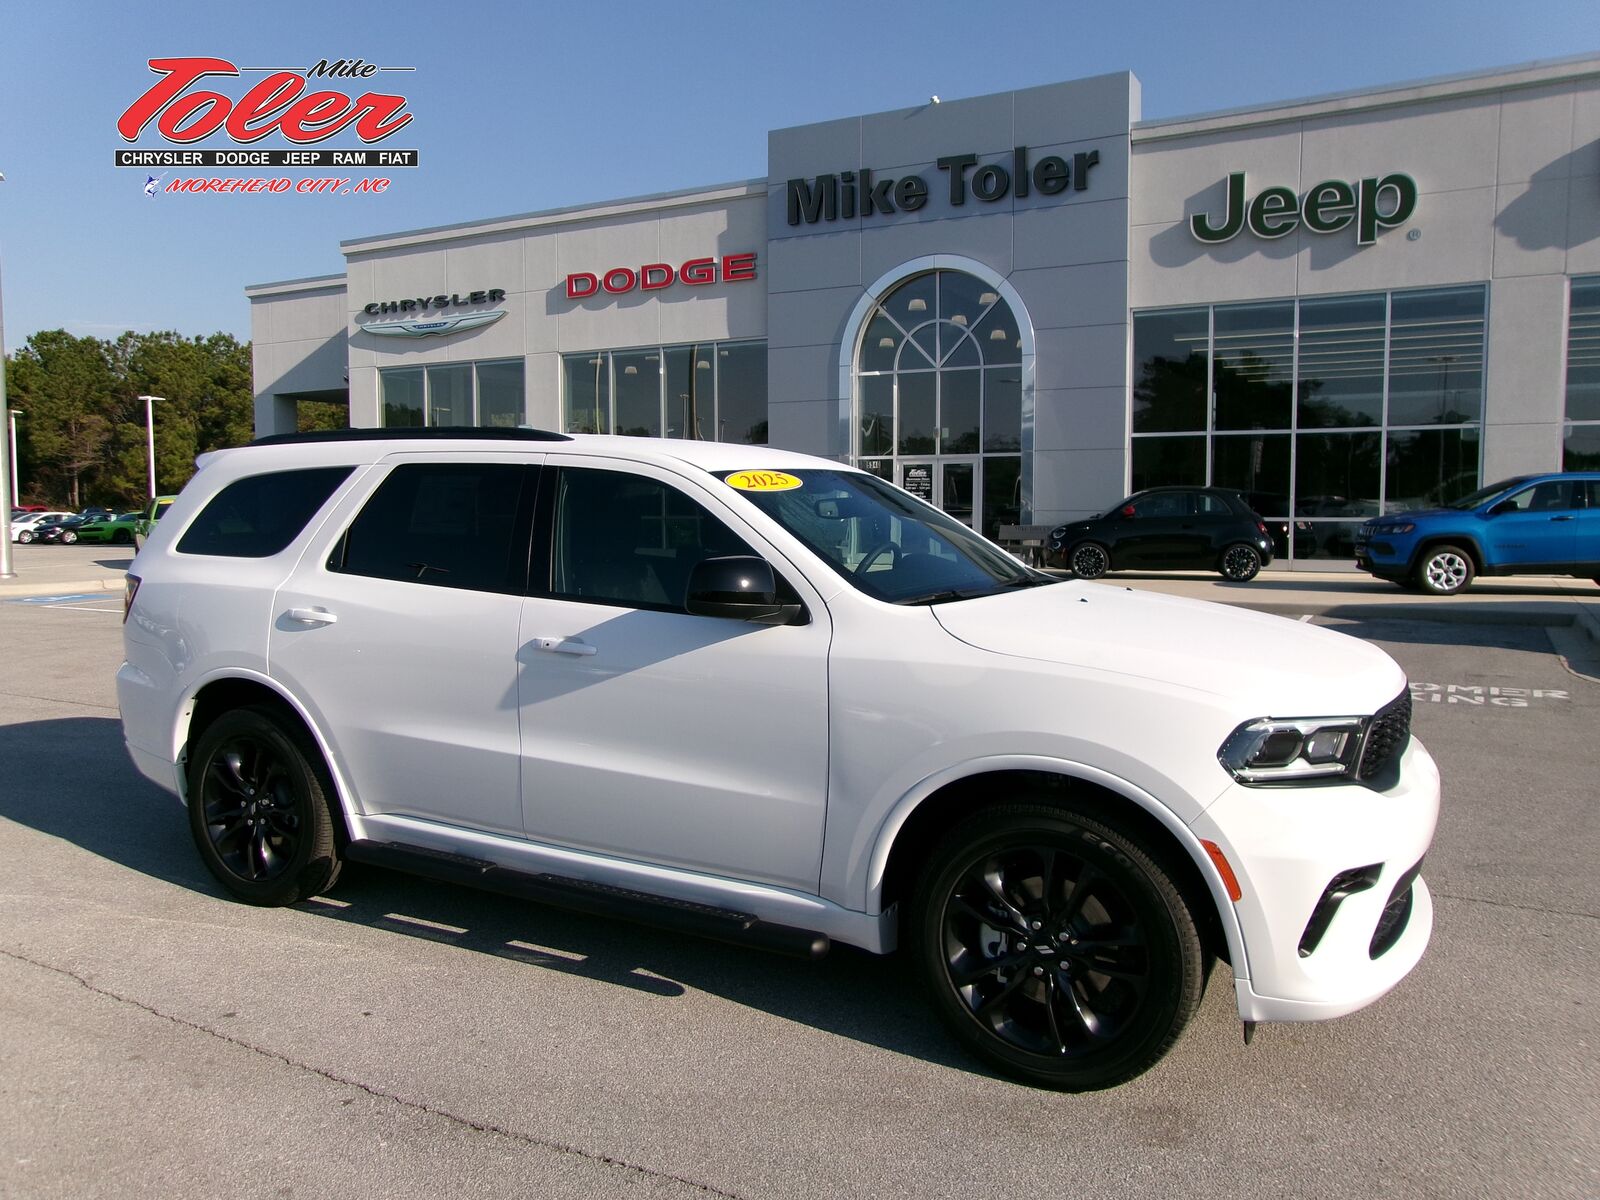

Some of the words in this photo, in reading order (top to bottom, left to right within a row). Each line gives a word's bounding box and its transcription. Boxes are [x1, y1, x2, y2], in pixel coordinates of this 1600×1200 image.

[787, 168, 928, 225] Mike
[937, 146, 1100, 205] Toler
[1190, 171, 1418, 246] Jeep
[566, 252, 757, 298] DODGE
[364, 288, 506, 316] CHRYSLER
[740, 473, 789, 488] 2025
